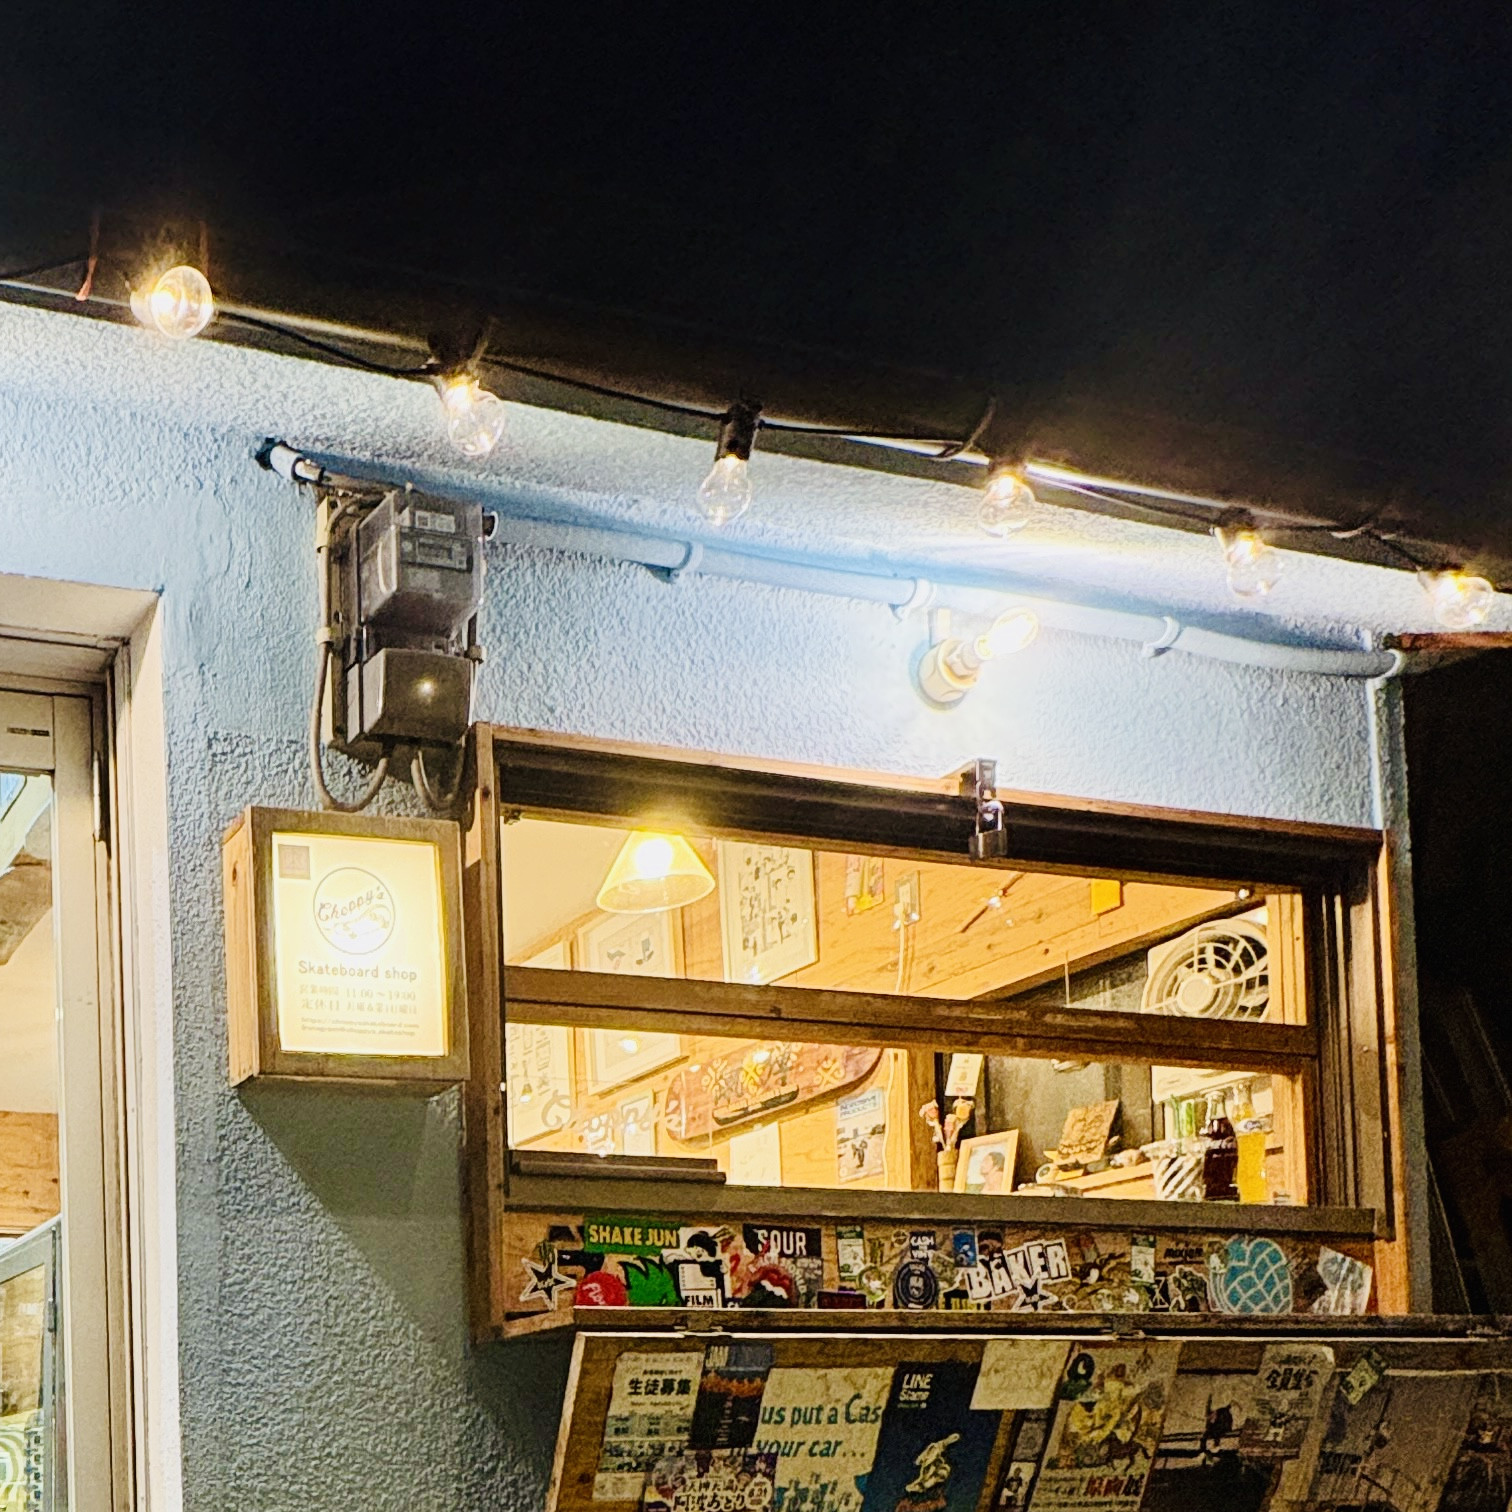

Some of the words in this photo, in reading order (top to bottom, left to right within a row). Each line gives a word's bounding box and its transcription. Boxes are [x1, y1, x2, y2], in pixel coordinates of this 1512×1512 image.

[297, 960, 378, 978] Skateboard
[385, 966, 417, 982] shop
[588, 1225, 642, 1246] SHAKE
[757, 1229, 808, 1257] SOUR
[684, 1294, 714, 1307] FILM
[627, 1378, 692, 1396] 生徒募集
[902, 1373, 934, 1390] LINE
[760, 1405, 786, 1425] us
[790, 1404, 824, 1428] put
[827, 1408, 838, 1425] a
